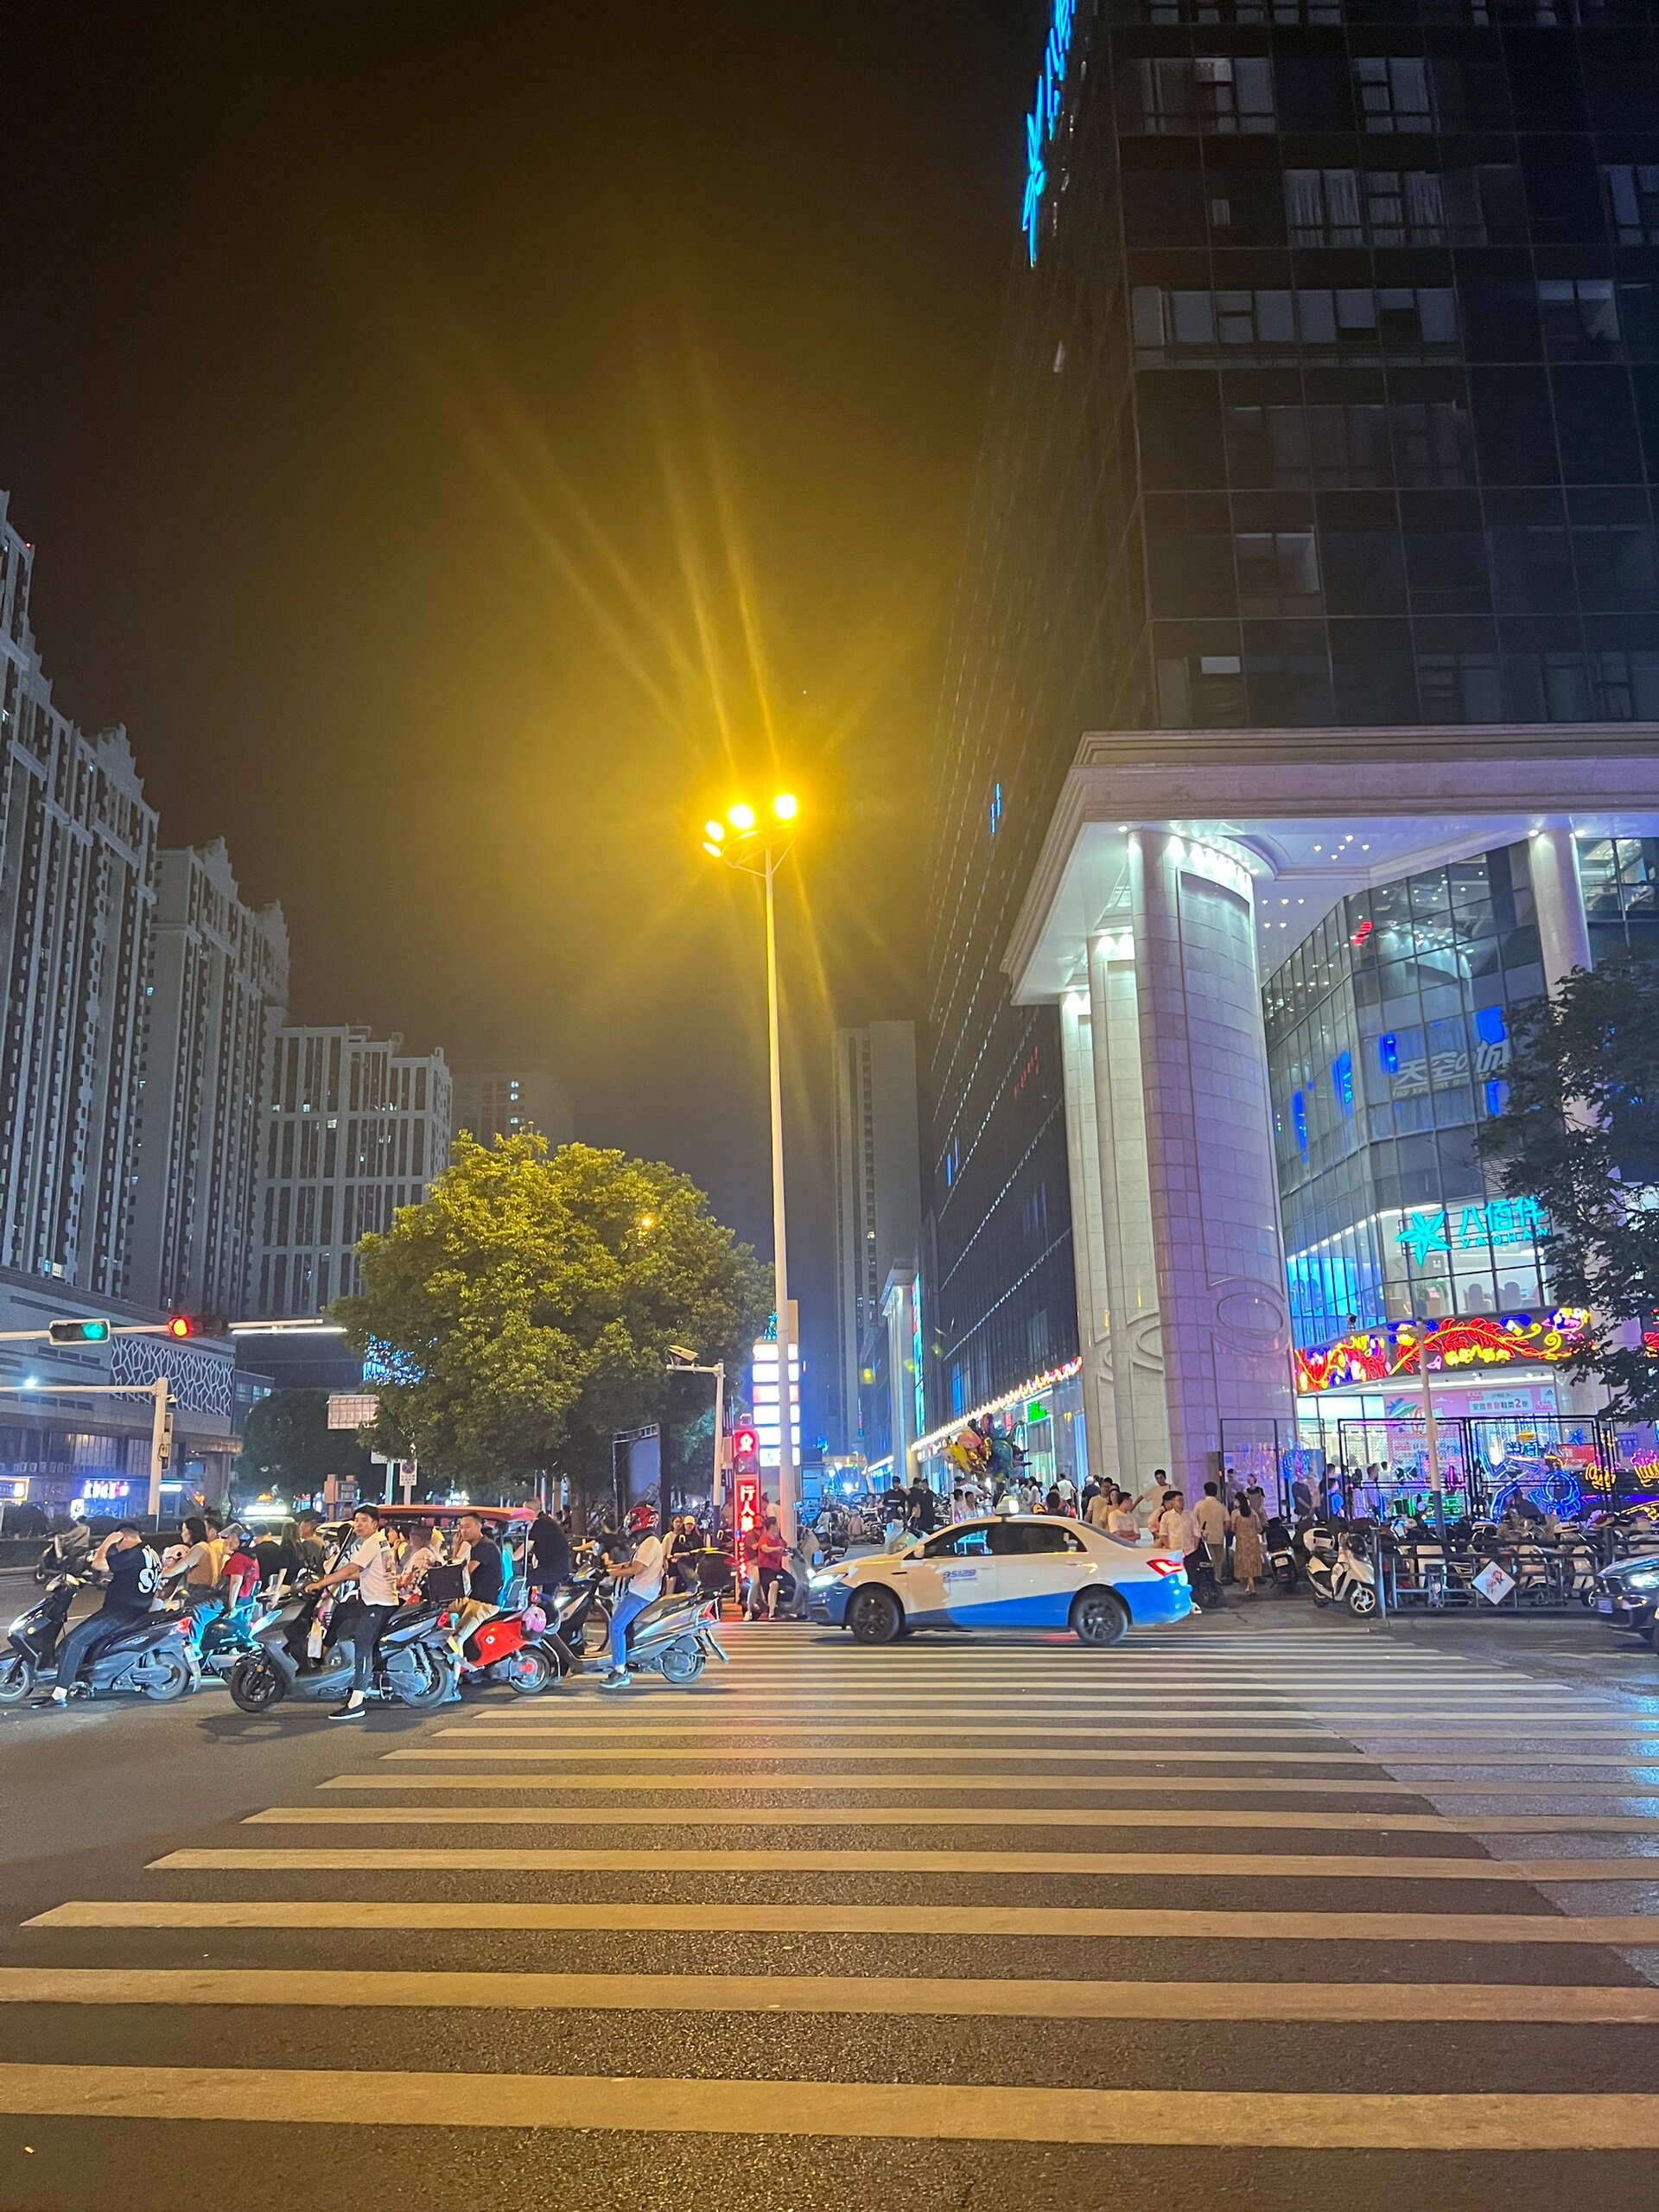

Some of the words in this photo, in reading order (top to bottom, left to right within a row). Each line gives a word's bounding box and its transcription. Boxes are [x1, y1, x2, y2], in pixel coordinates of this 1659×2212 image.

[1459, 1196, 1545, 1236] 八佰伴
[1460, 1228, 1550, 1249] YAOHAN
[943, 1569, 976, 1578] 95128
